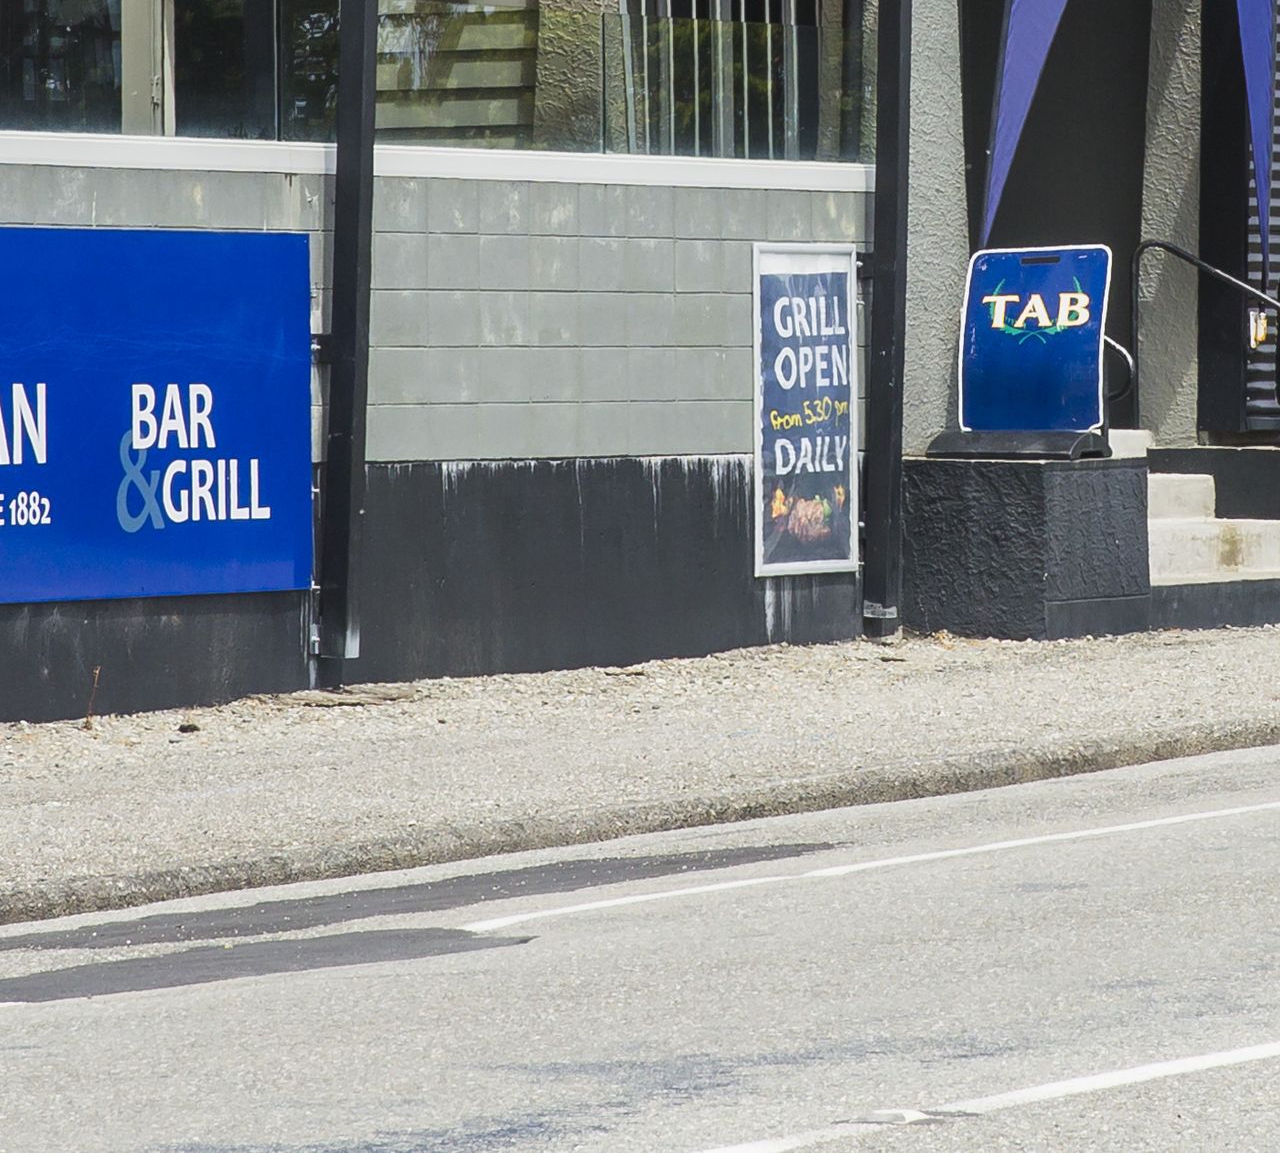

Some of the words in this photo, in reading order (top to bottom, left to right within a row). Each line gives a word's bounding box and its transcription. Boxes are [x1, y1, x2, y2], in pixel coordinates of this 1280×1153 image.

[773, 296, 846, 339] GRILL
[982, 293, 1090, 328] TAB
[774, 344, 849, 390] OPEN
[132, 383, 217, 450] BAR
[770, 410, 803, 430] from
[774, 435, 847, 475] DAILY
[9, 492, 52, 527] 1882
